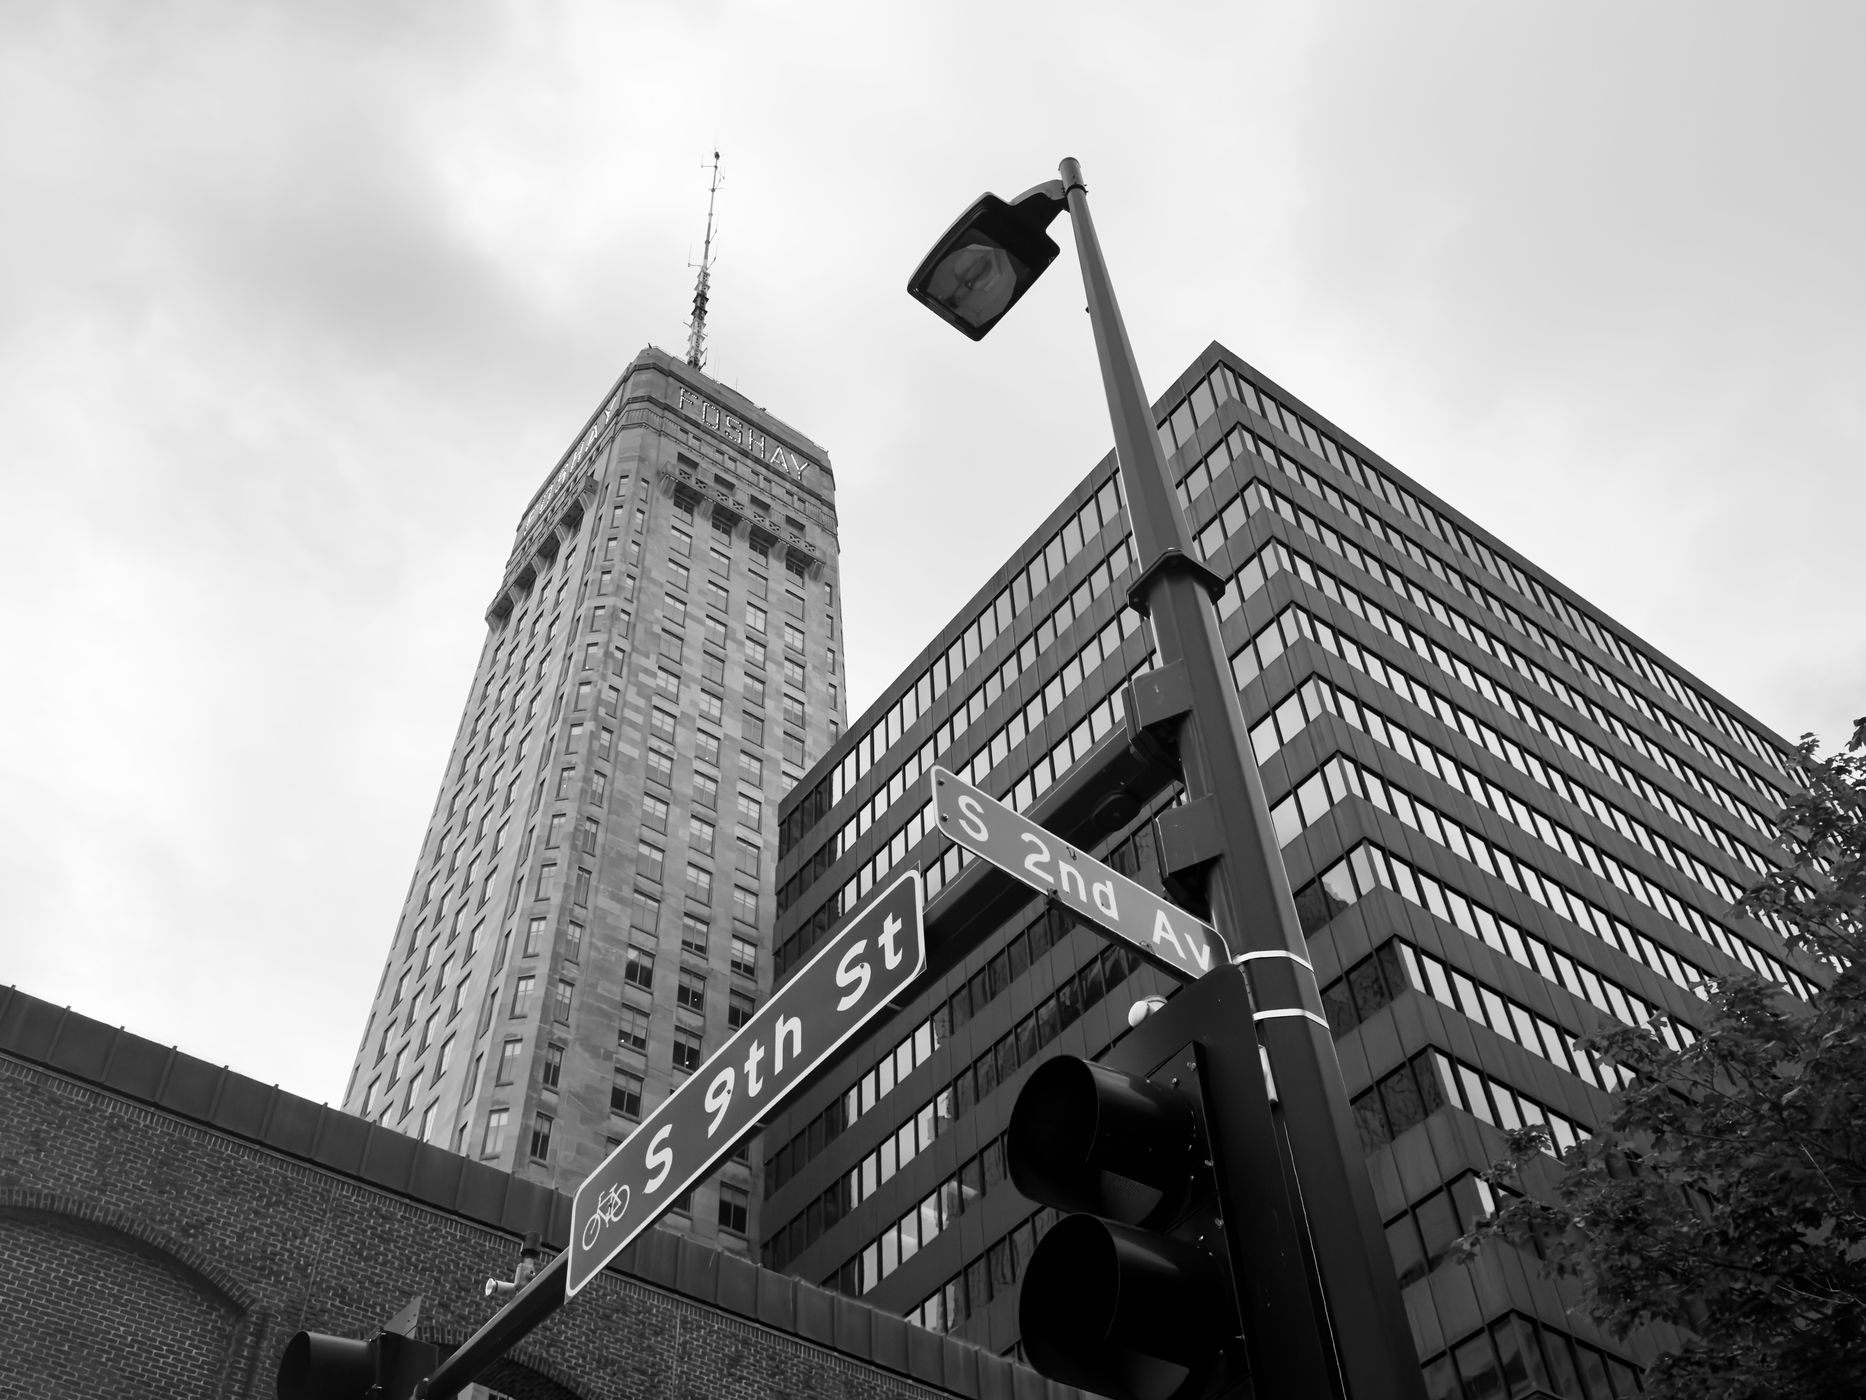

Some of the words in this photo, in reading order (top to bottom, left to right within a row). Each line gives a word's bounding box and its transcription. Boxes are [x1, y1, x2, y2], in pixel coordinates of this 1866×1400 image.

[679, 386, 809, 480] FOSHAY
[957, 795, 989, 842] S
[1020, 832, 1119, 921] 2nd
[1152, 909, 1211, 971] Av
[642, 1123, 673, 1195] S
[704, 1014, 802, 1139] 9th
[835, 912, 903, 1011] St
